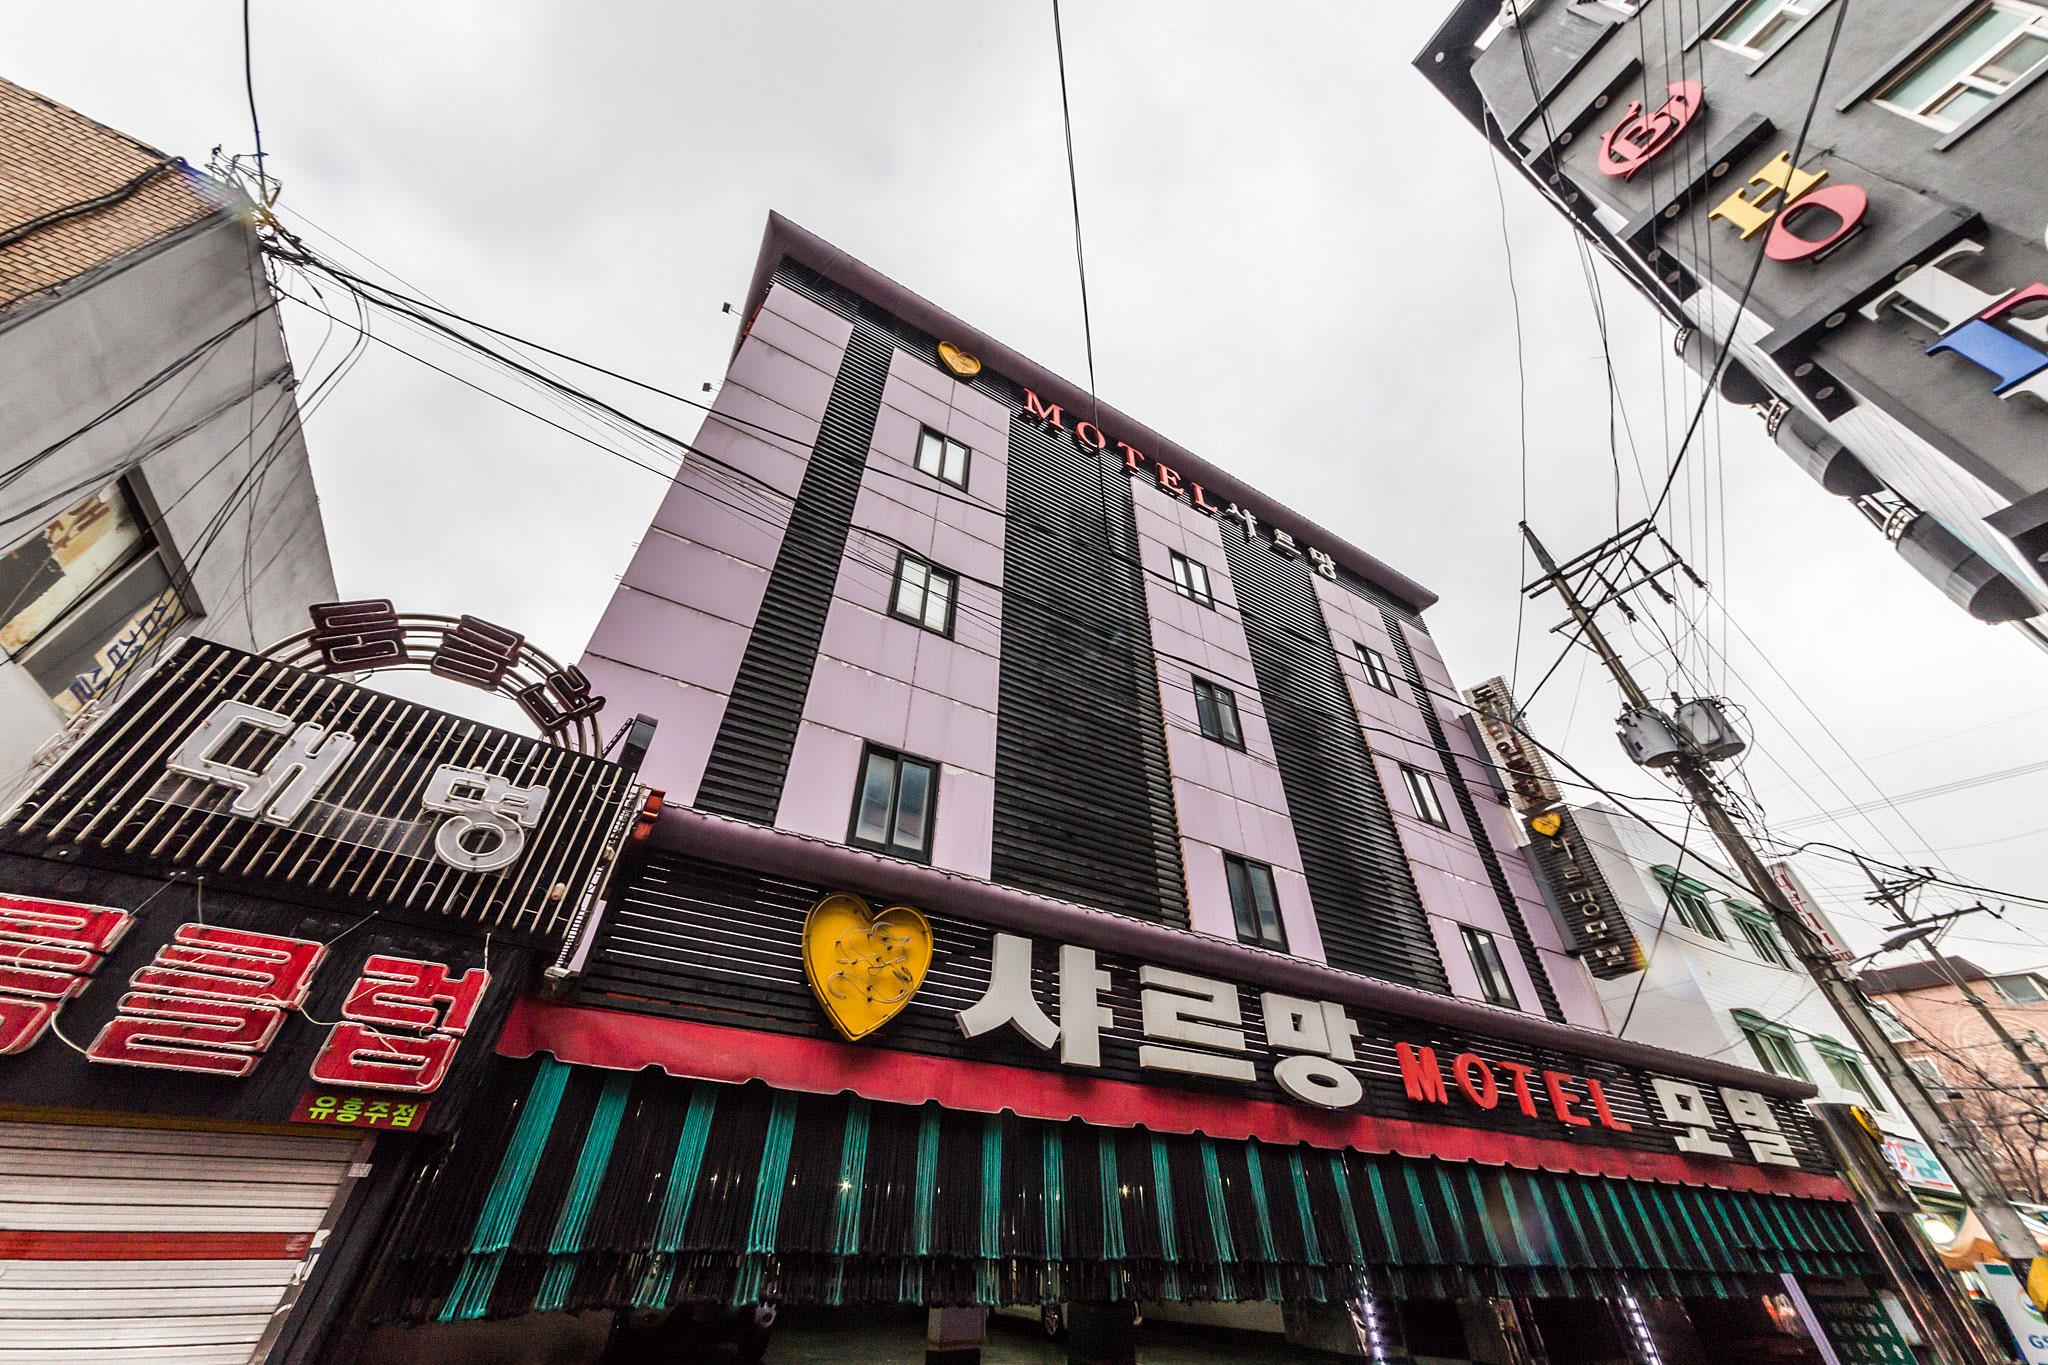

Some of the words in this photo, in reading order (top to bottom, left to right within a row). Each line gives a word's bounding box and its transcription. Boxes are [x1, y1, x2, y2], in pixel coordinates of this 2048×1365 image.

[1022, 388, 1218, 513] MOTEL
[1225, 502, 1338, 580] 사르망
[307, 1096, 420, 1127] 유흥주점
[955, 932, 1364, 1110] 사르망
[1395, 1041, 1633, 1133] MOTEL
[1651, 1078, 1801, 1168] 모텔
